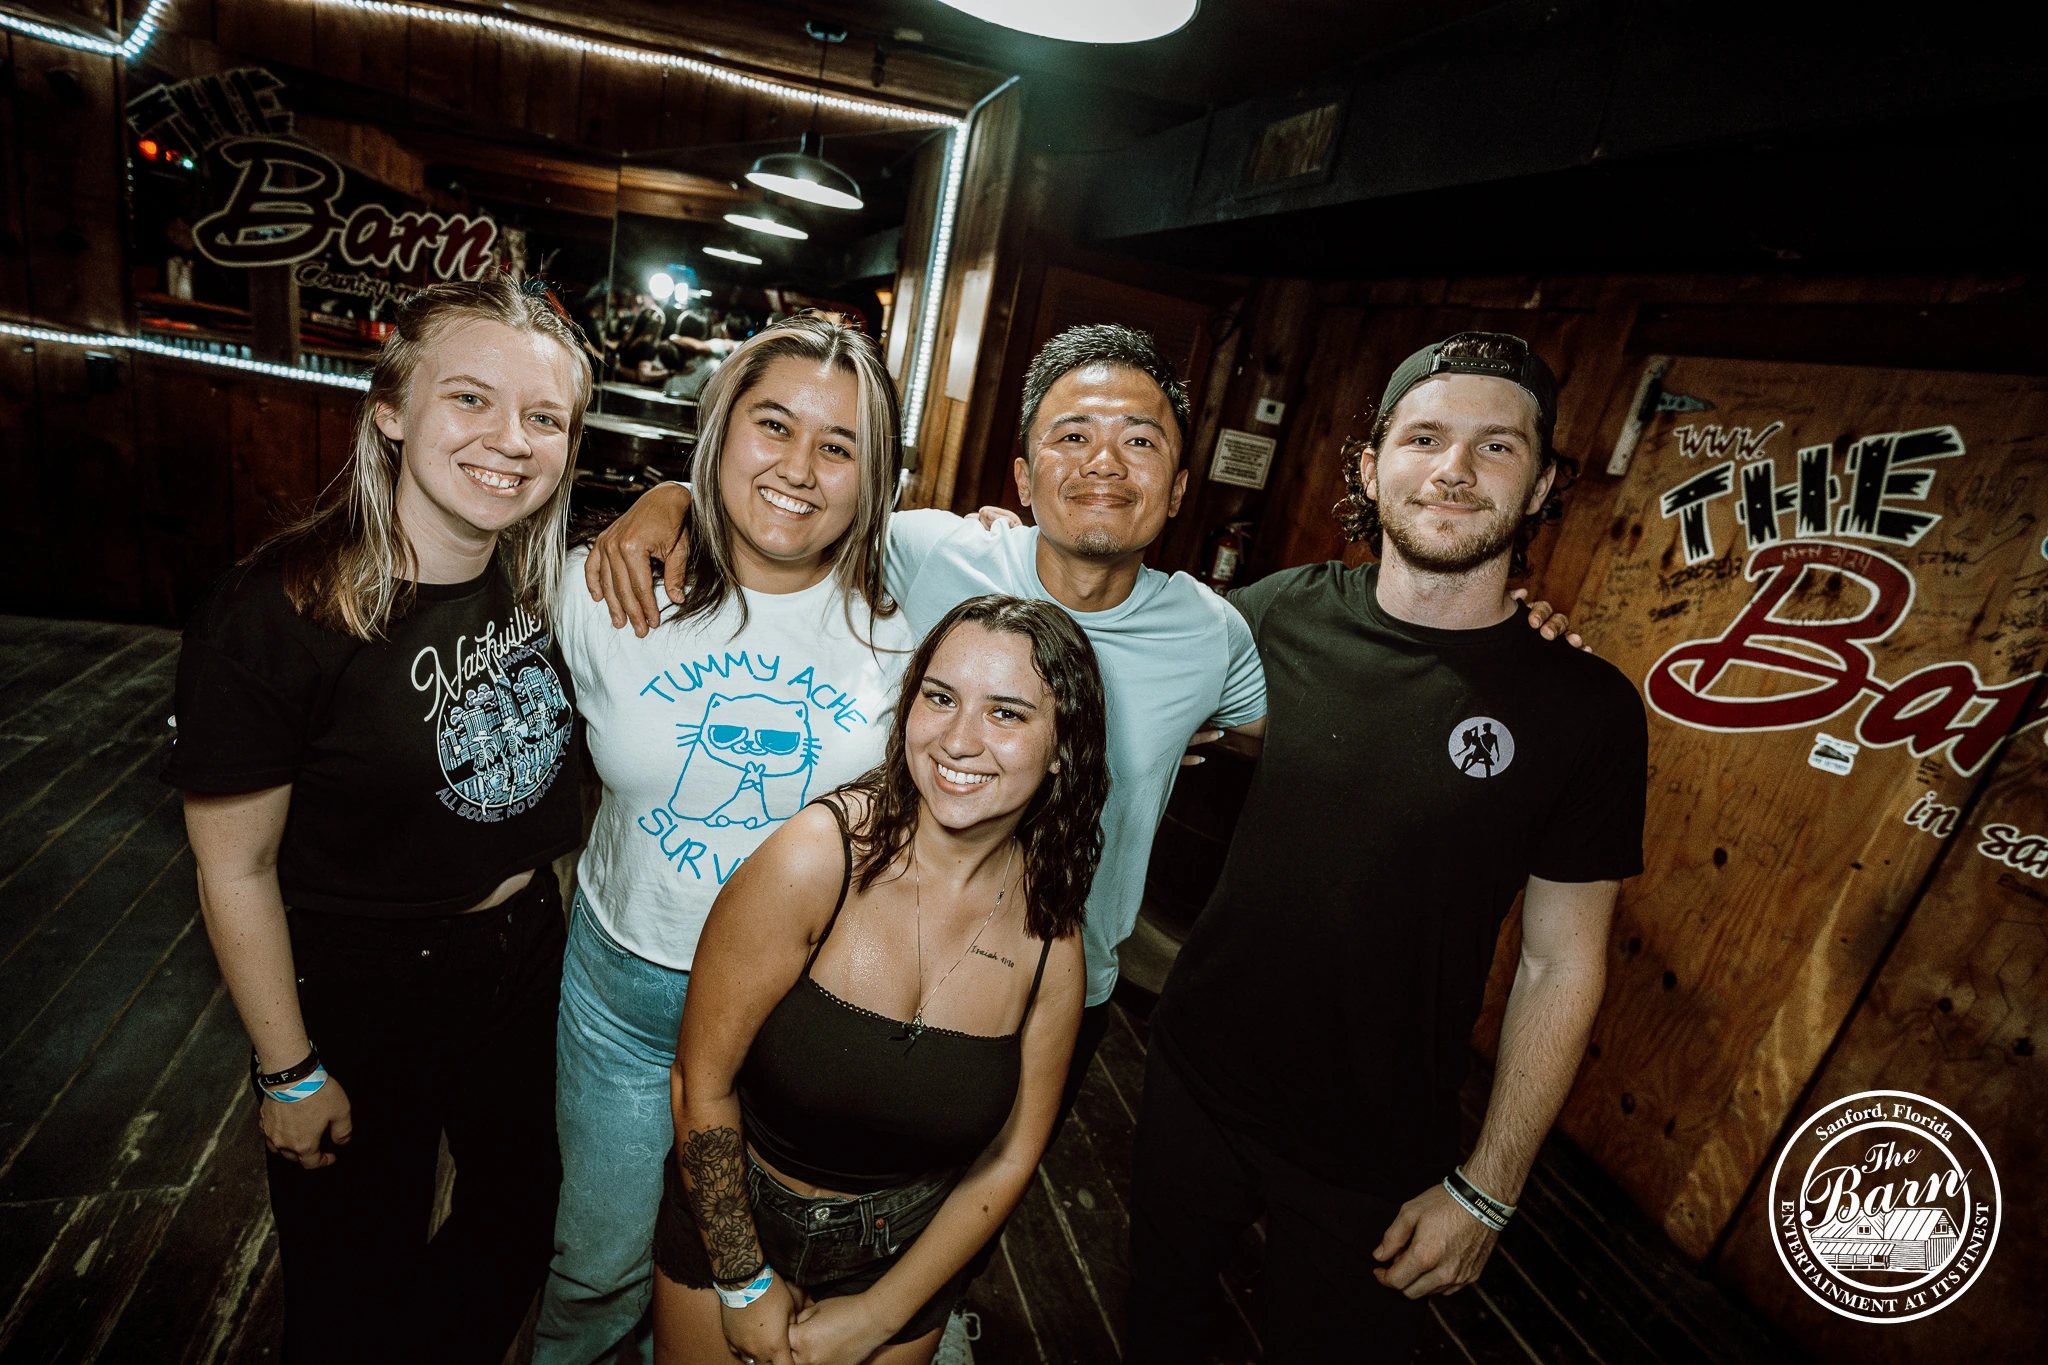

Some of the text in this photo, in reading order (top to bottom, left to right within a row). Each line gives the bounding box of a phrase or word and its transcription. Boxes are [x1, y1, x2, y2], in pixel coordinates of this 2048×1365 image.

[126, 67, 296, 159] THE
[192, 138, 498, 282] Barn
[295, 260, 392, 309] Country
[1660, 424, 1966, 567] THE
[500, 643, 535, 669] DANCE
[639, 650, 868, 733] TUMMY ACHE
[1644, 538, 2048, 778] Bar
[435, 787, 459, 812] ALL
[456, 802, 505, 824] BOOGIE.
[506, 802, 525, 819] NO
[528, 761, 564, 808] DRAMA.
[637, 807, 749, 886] SURV
[1903, 790, 2048, 880] in sa
[970, 945, 999, 961] Isaiah
